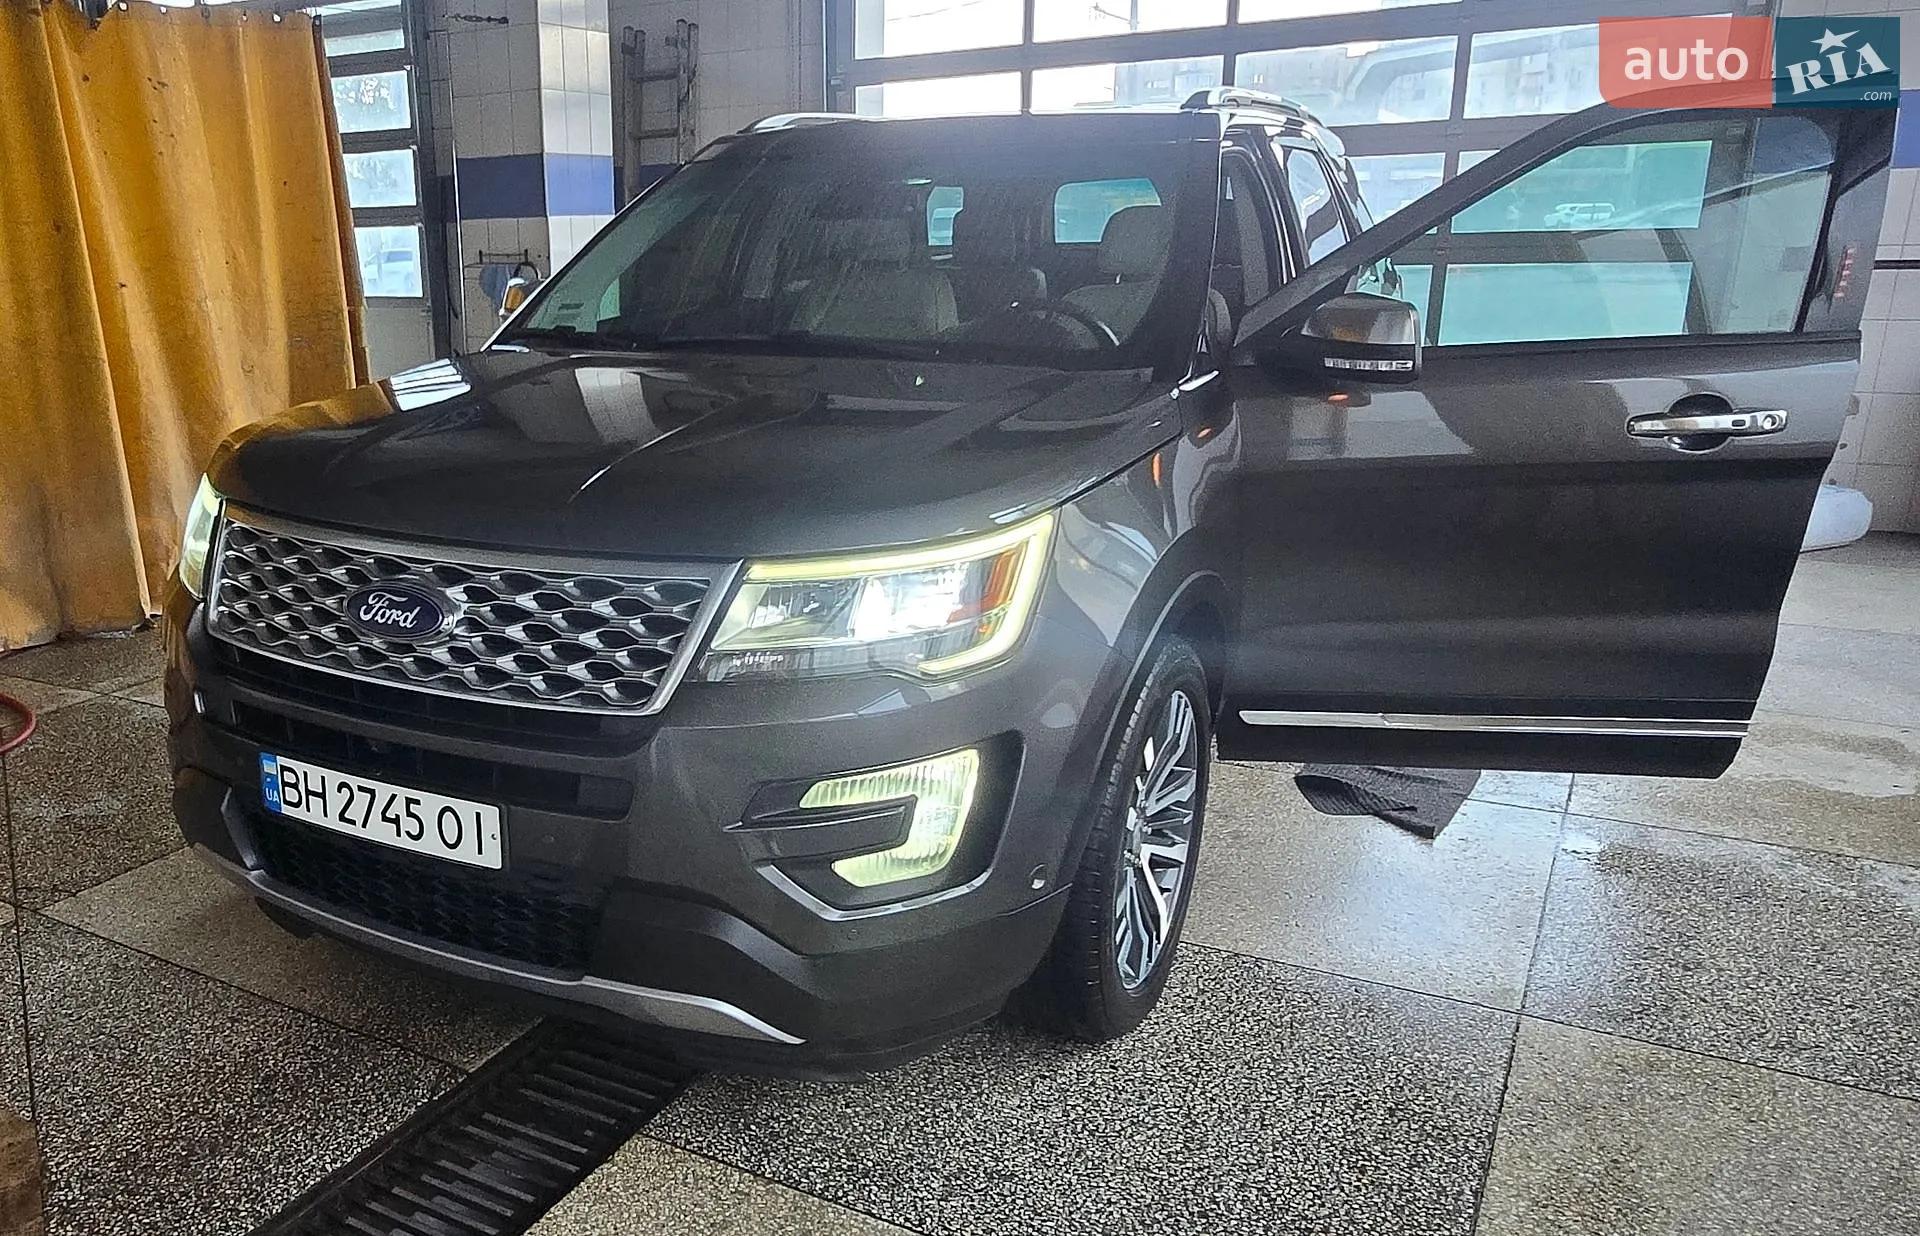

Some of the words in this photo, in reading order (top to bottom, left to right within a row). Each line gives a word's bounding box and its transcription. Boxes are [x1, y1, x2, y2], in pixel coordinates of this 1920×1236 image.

[360, 592, 421, 628] Ford
[265, 787, 280, 804] UA
[279, 764, 328, 818] BH
[336, 781, 425, 841] 2745
[437, 805, 483, 855] OI
